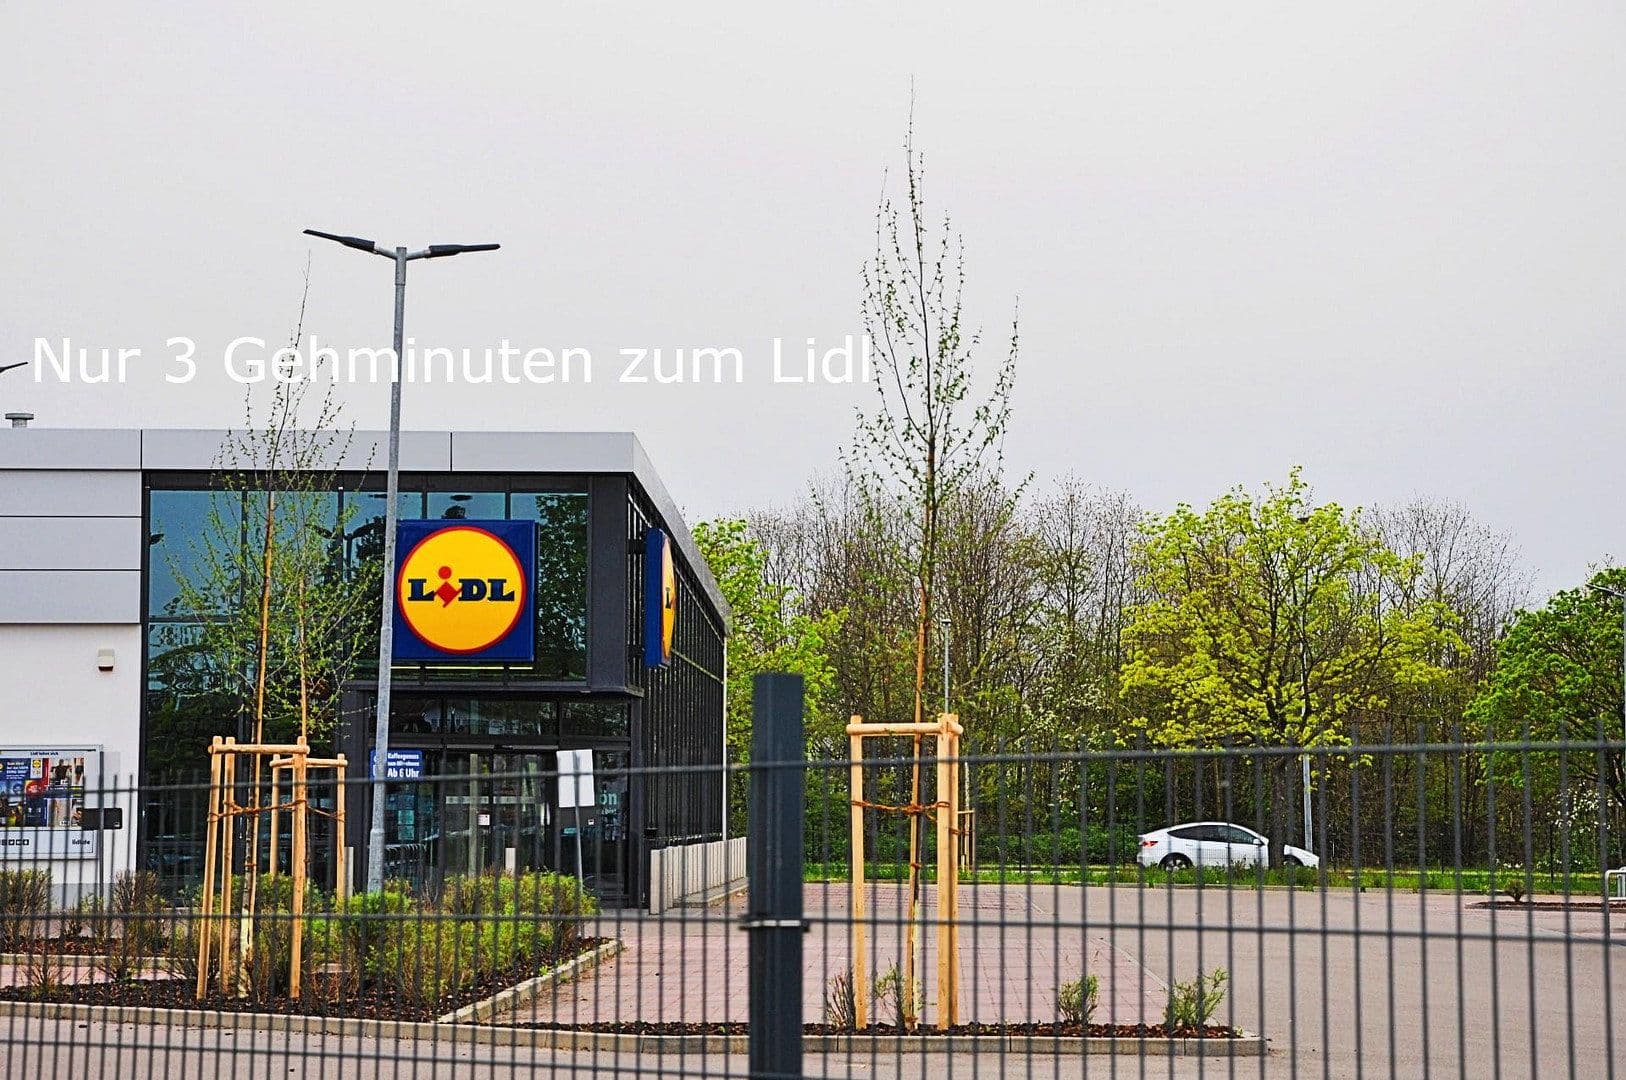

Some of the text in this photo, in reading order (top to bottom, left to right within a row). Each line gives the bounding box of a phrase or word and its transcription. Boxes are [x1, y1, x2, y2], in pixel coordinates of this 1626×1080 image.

[408, 566, 515, 608] LIDL
[387, 768, 420, 778] Ab 6 Uhr
